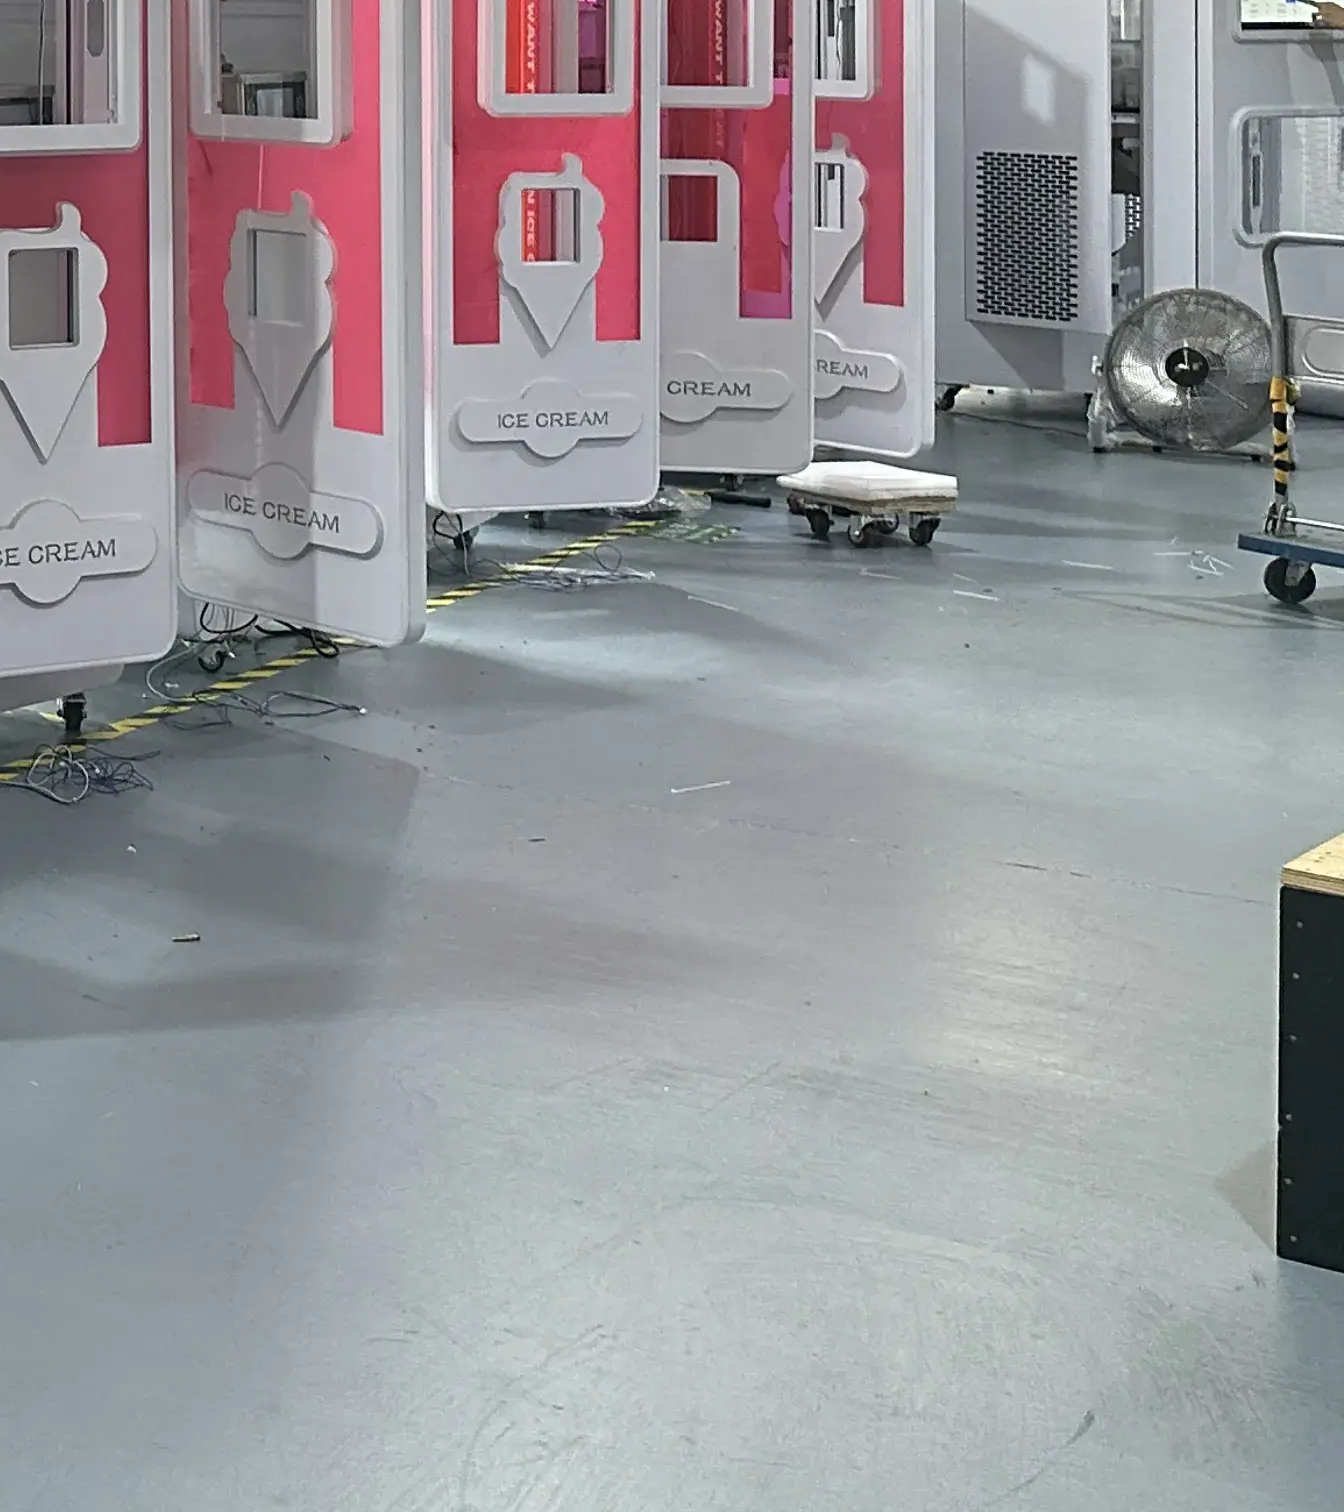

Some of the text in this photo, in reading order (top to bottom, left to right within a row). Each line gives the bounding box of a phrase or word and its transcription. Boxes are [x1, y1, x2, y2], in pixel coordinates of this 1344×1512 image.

[526, 2, 536, 73] WANT
[714, 0, 723, 65] WANT
[526, 80, 536, 93] T
[715, 73, 724, 84] T
[815, 358, 869, 380] REAM
[666, 380, 752, 398] CREAM
[496, 410, 609, 430] ICE CREAM
[224, 491, 340, 534] ICE CREAM
[28, 537, 116, 565] CREAM
